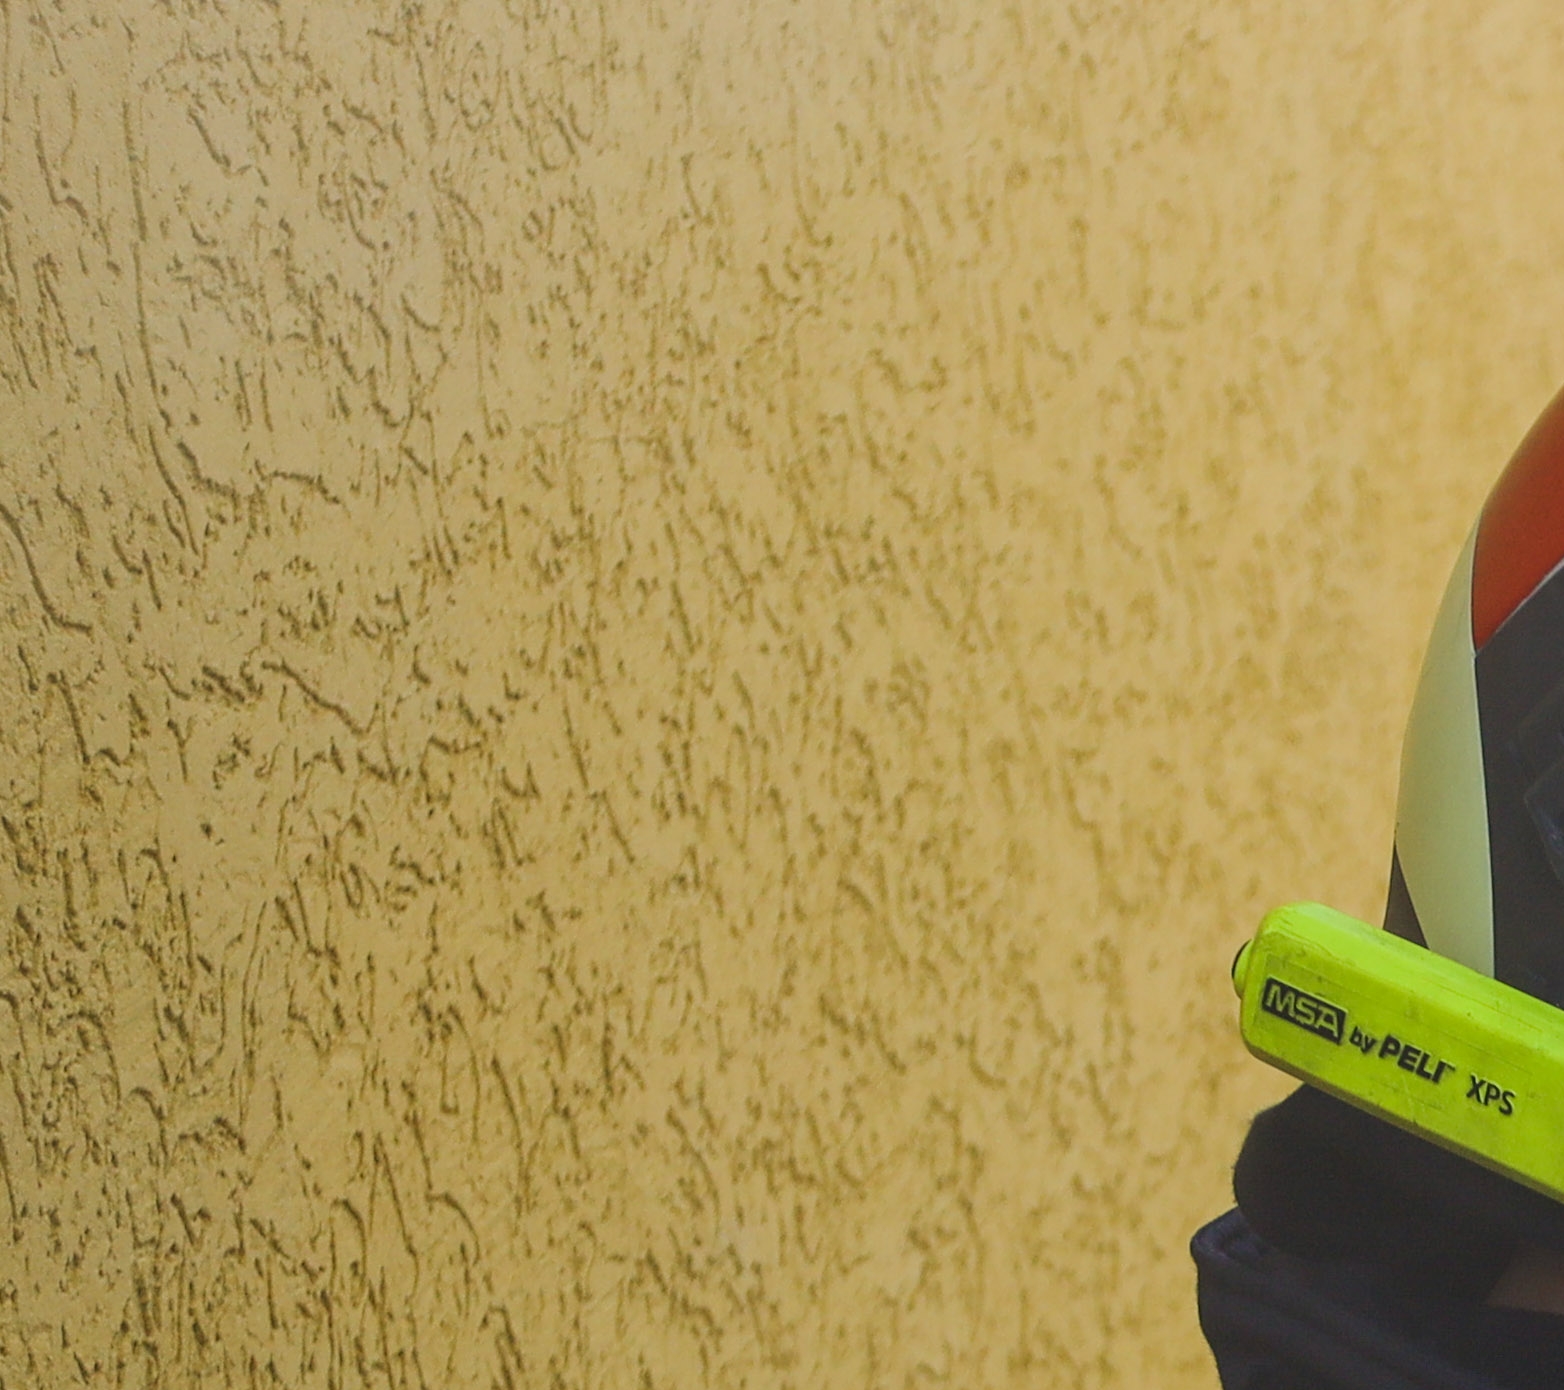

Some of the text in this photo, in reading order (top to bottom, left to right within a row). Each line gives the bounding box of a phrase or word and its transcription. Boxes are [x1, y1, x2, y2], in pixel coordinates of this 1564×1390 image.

[1264, 982, 1516, 1115] MSA by PELI XPS
